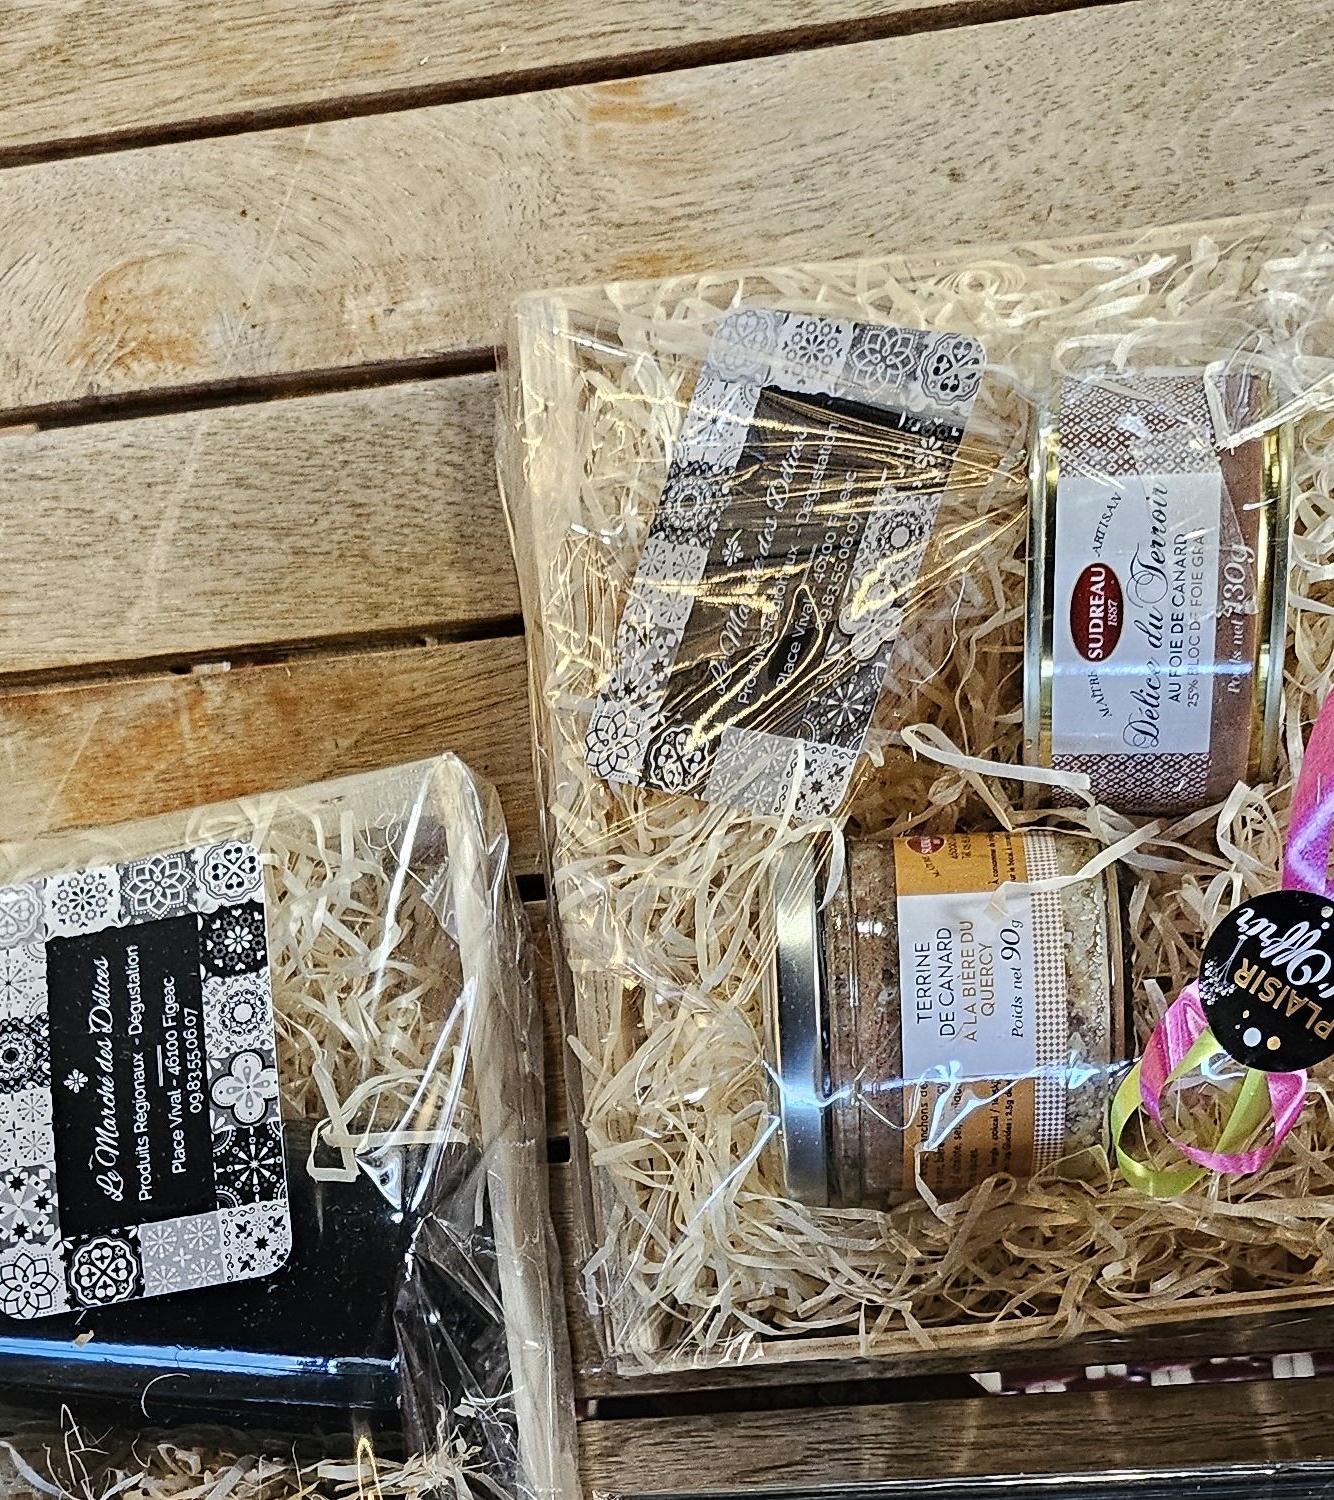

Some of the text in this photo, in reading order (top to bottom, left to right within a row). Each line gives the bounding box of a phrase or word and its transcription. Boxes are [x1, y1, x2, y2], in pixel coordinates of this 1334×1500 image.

[753, 517, 780, 553] des
[1092, 491, 1123, 557] ARTISAN
[789, 597, 814, 637] Vival
[812, 531, 837, 582] 46100
[1088, 566, 1105, 659] SUDREAU
[1123, 480, 1168, 748] Délice du Terroir
[1169, 533, 1187, 703] AU FOIE DE CANARD
[1191, 571, 1203, 607] FOIE
[1188, 680, 1199, 707] 25%
[914, 941, 932, 1023] TERRINE
[936, 927, 955, 1036] DE CANARD
[957, 920, 977, 1024] LA BIÈRE DU
[978, 942, 995, 1017] QUERCY
[999, 919, 1024, 1038] Poids net 90g
[88, 955, 124, 1201] Le Marché des Délices
[126, 944, 153, 1201] Produits Régionaux Dégustation
[162, 976, 188, 1174] Place Vival 46100 Figeac
[184, 1007, 204, 1114] 09.83.55.06.07
